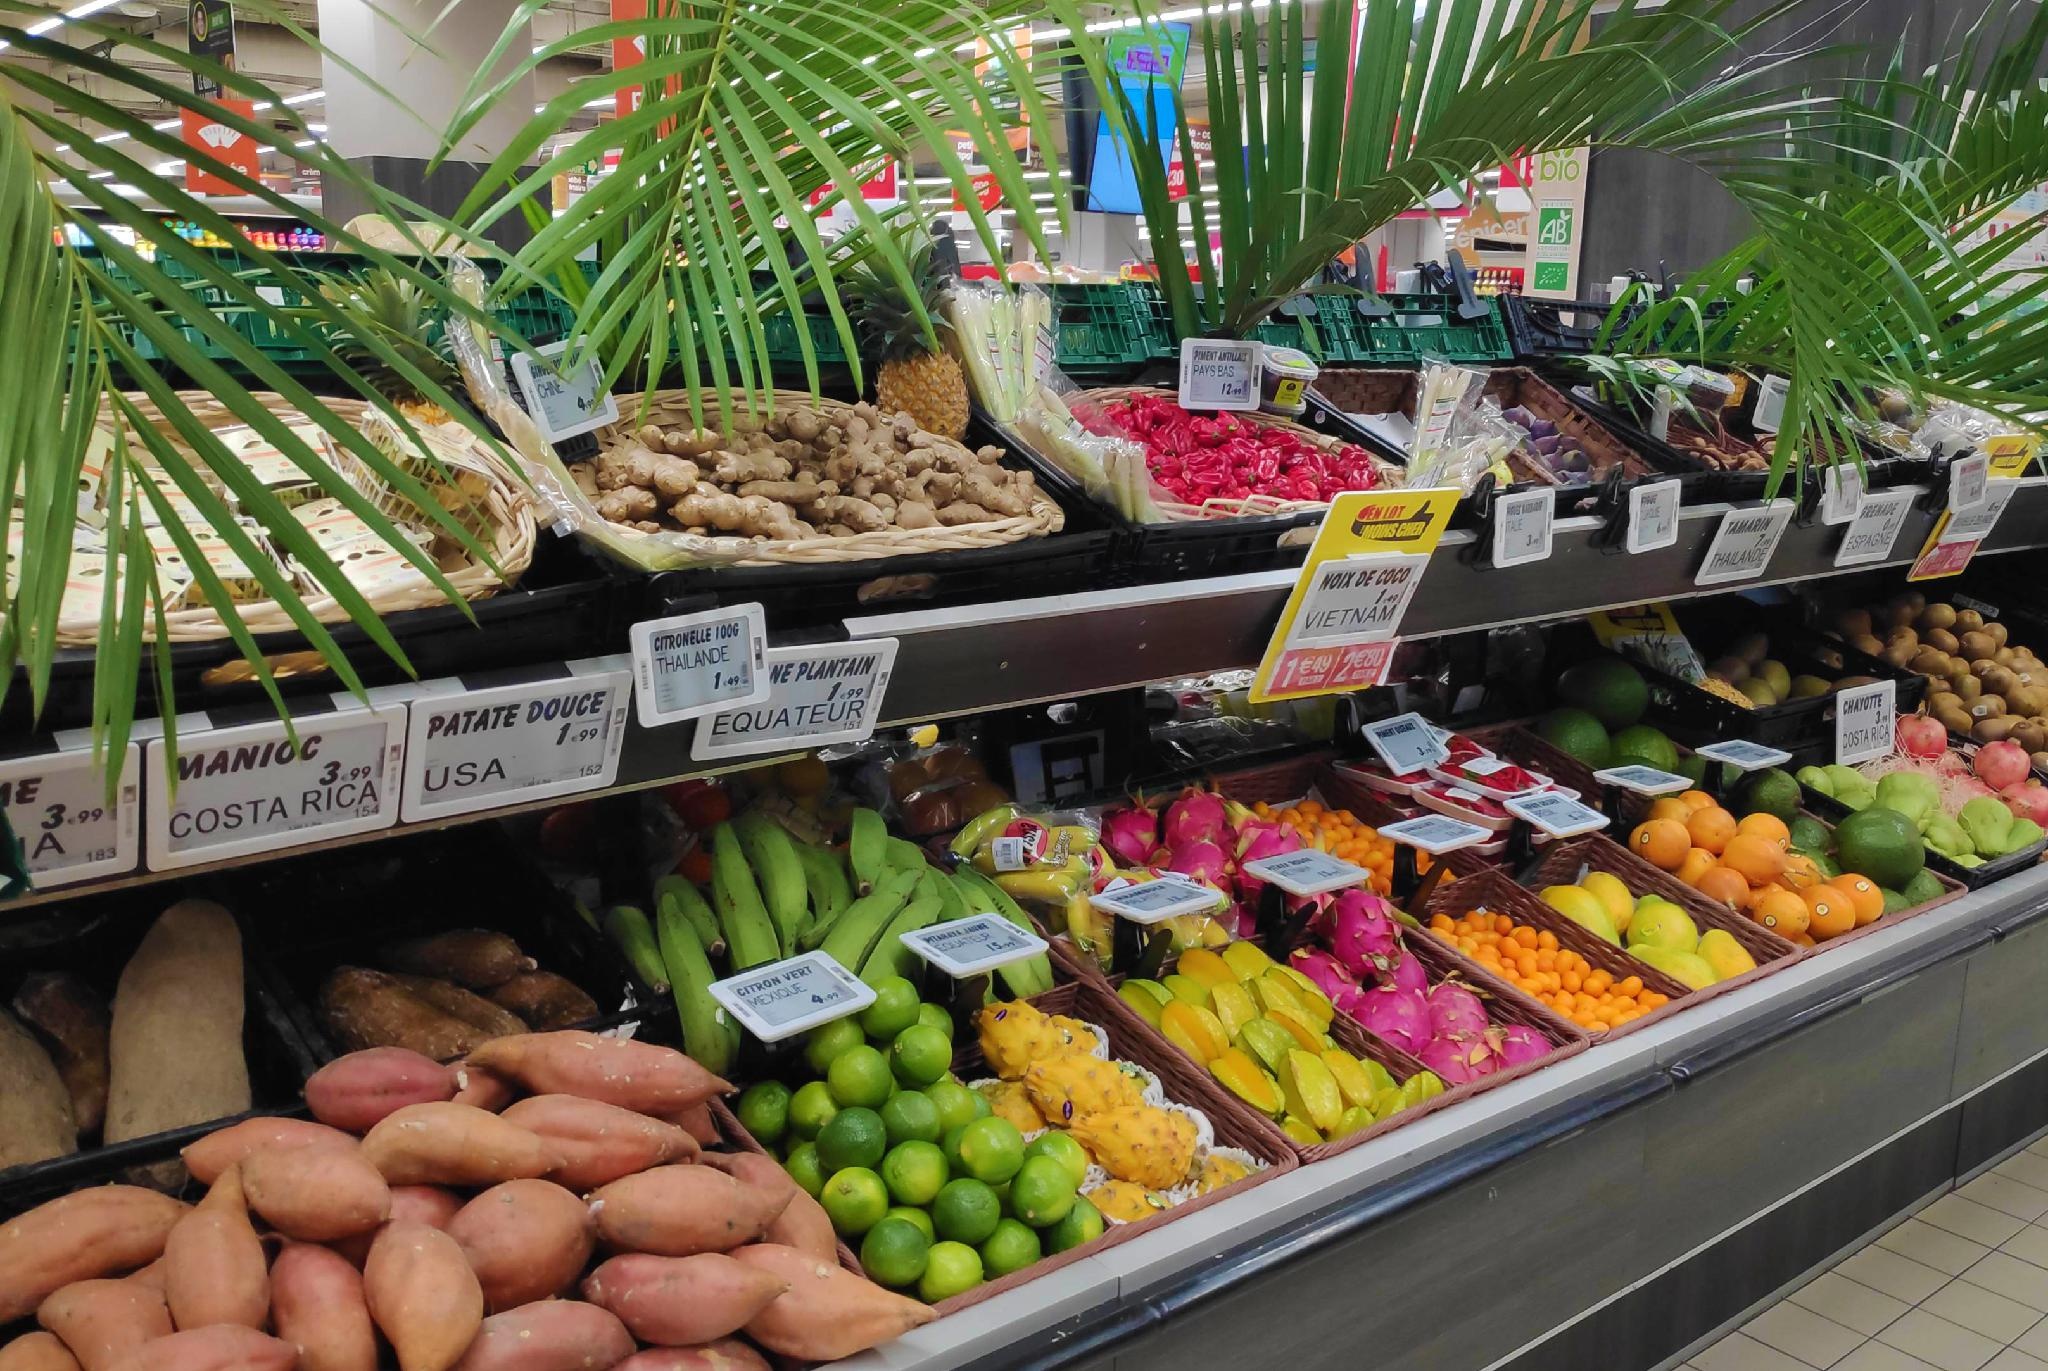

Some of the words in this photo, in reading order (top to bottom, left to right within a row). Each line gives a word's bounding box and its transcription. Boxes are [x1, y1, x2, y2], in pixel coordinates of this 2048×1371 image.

[1540, 218, 1567, 244] AB
[1194, 350, 1217, 362] PIMENT
[1193, 364, 1216, 378] PAYS
[1218, 365, 1235, 378] BAS
[1384, 505, 1406, 520] LOT
[1361, 524, 1399, 540] MOINS
[1398, 522, 1426, 539] CHER
[1724, 516, 1774, 537] TAMARIN
[1845, 531, 1893, 550] ESPAGNE
[1709, 547, 1769, 569] THAILANDE
[1318, 571, 1355, 592] NOIX
[1355, 570, 1376, 587] DE
[1375, 567, 1412, 586] COCO
[1304, 604, 1397, 630] VIETNAM
[654, 626, 712, 652] CITRONELLE
[714, 622, 739, 641] 100G
[655, 645, 730, 675] THAILANDE
[794, 655, 876, 682] PLANTAIN
[427, 703, 521, 740] PATATE
[526, 691, 608, 724] DOUCE
[1843, 693, 1882, 715] CHAYOTTE
[711, 700, 865, 736] EQUATEUR
[842, 720, 863, 731] 151
[1843, 729, 1869, 749] COSTA
[1871, 724, 1890, 742] RICA
[178, 735, 323, 782] MANIOC
[579, 764, 603, 777] 152
[424, 757, 506, 792] USA
[168, 796, 289, 840] COSTA
[302, 779, 379, 816] RICA
[355, 803, 380, 818] 154
[86, 847, 116, 862] 183
[736, 976, 782, 998] CITRON
[783, 965, 813, 982] VERT
[750, 982, 808, 1009] MEXIQUE
